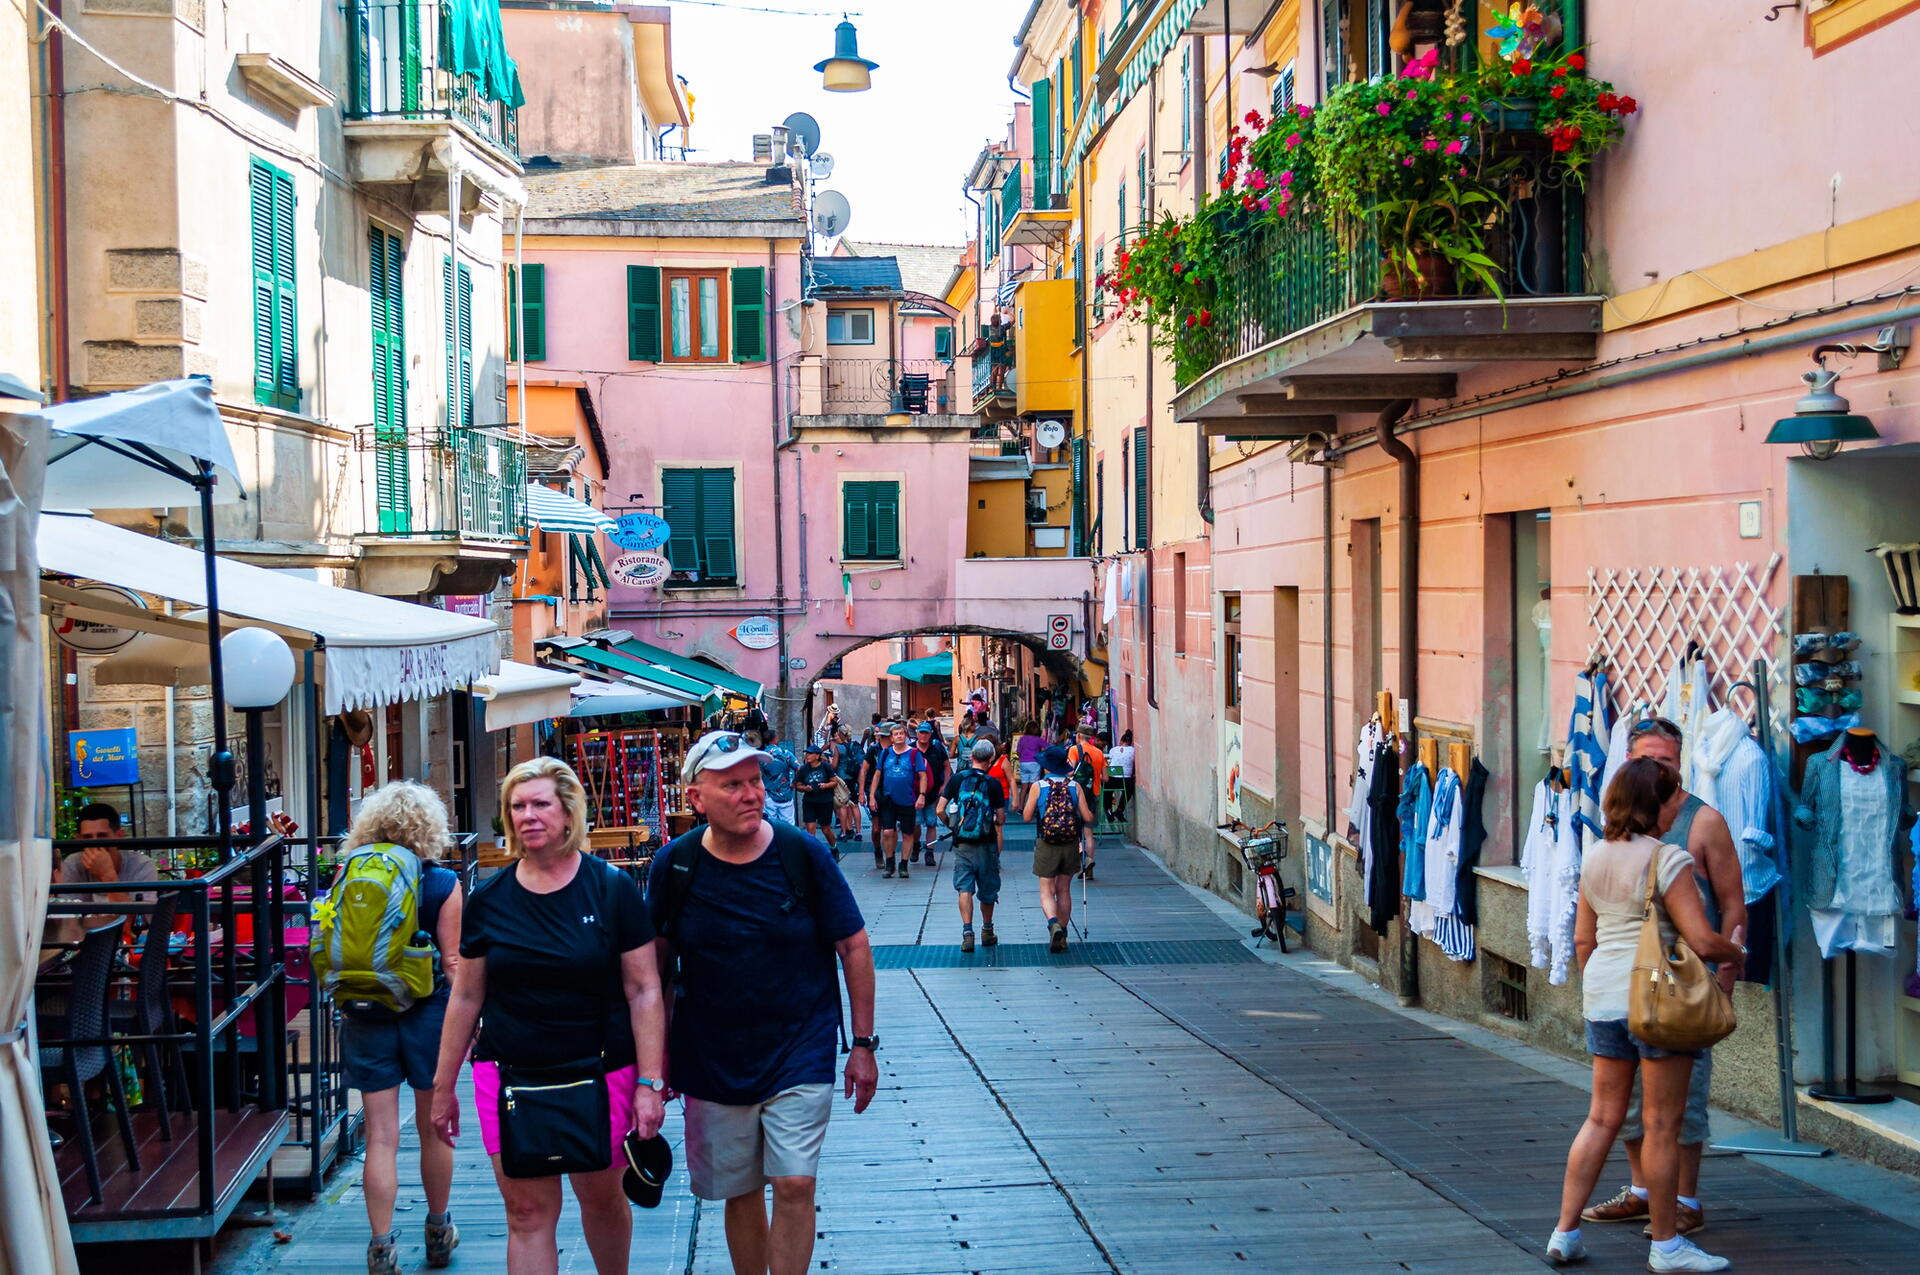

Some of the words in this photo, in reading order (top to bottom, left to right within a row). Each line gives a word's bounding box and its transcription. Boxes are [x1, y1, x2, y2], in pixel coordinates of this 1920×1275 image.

[619, 536, 661, 549] Camere
[617, 556, 665, 568] Ristorante
[620, 576, 630, 584] Al
